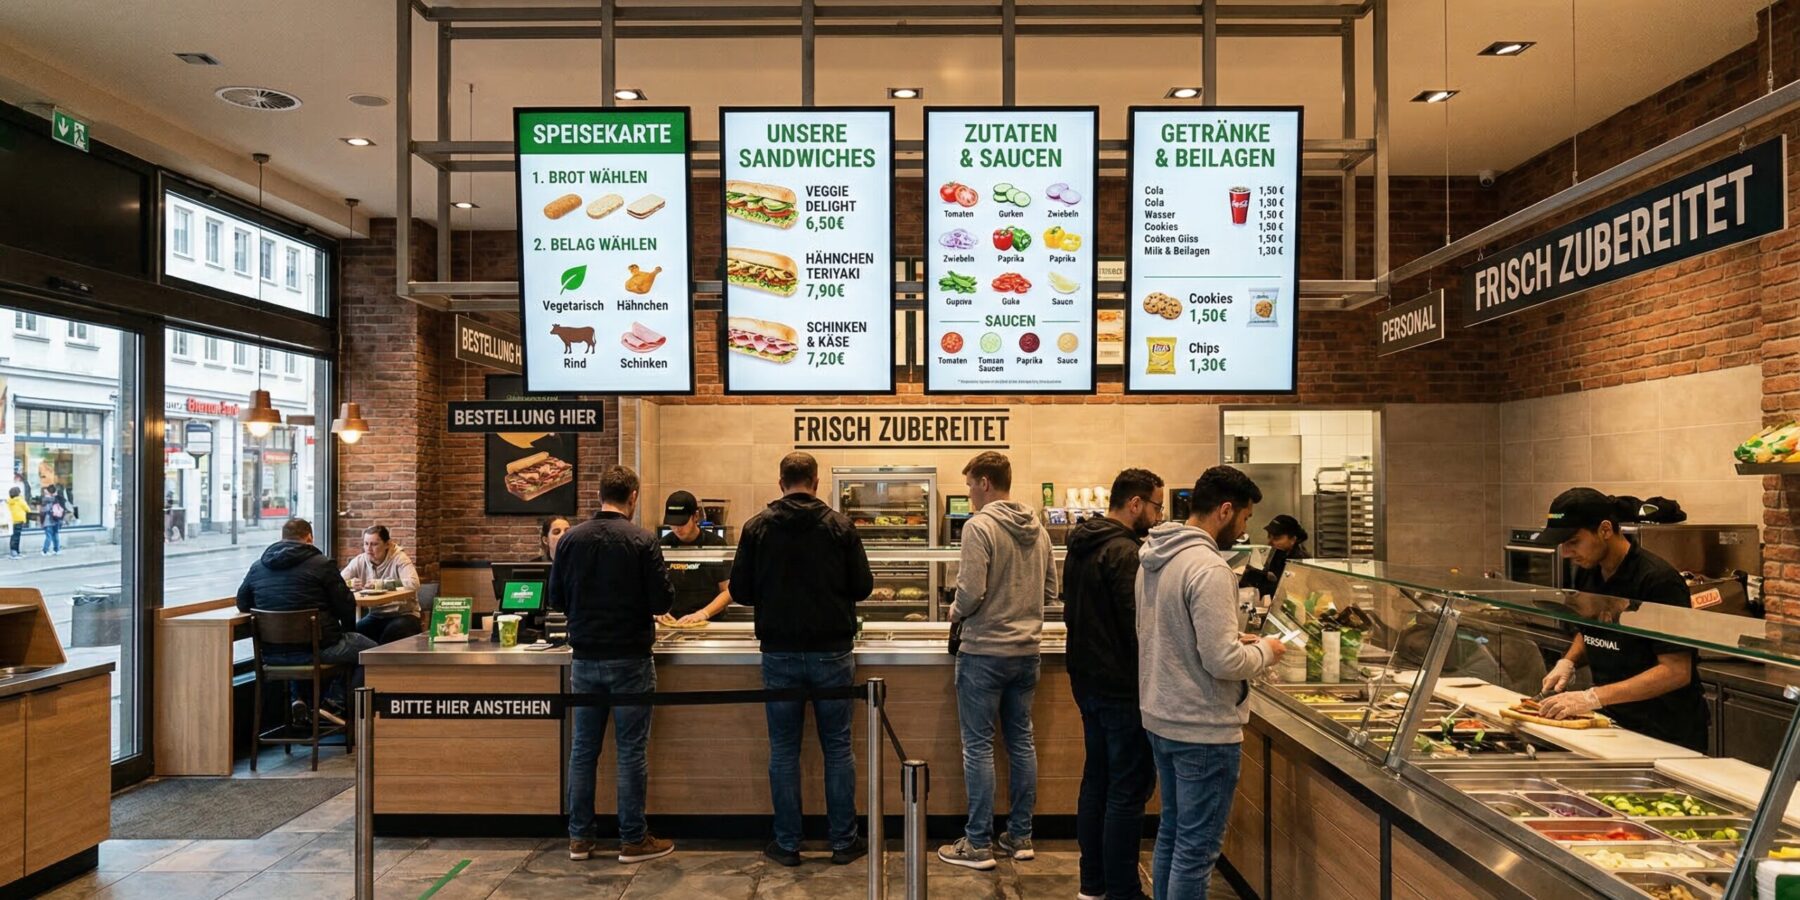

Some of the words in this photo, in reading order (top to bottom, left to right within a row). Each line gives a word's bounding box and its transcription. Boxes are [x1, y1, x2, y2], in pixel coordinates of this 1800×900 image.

[533, 123, 672, 144] SPEISEKARTE
[767, 123, 847, 143] UNSERE
[964, 123, 1057, 143] ZUTATEN
[1161, 119, 1270, 143] GETRÄNKE
[739, 148, 876, 168] SANDWICHES
[959, 148, 974, 168] &
[980, 148, 1062, 168] SAUCEN
[1155, 148, 1169, 168] &
[1175, 148, 1275, 168] BEILAGEN
[532, 171, 544, 184] 1.
[549, 170, 585, 184] BROT
[589, 167, 648, 184] WÄHLEN
[805, 185, 849, 197] VEGGIE
[1144, 185, 1164, 195] Cola
[1259, 185, 1278, 196] 1,50
[805, 200, 857, 212] DELIGHT
[1144, 197, 1165, 207] Cola
[943, 210, 974, 218] Tomaten
[998, 210, 1024, 218] Gurken
[1047, 210, 1079, 218] Zwiebeln
[1144, 210, 1176, 219] Wasser
[1259, 209, 1277, 220] 1,50
[805, 216, 845, 232] 6,50€
[1144, 221, 1179, 231] Cookies
[1259, 221, 1277, 232] 1,50
[533, 238, 546, 251] 2.
[550, 237, 595, 251] BELAG
[598, 234, 657, 251] WÄHLEN
[1258, 233, 1277, 245] 1,50
[1475, 245, 1552, 312] FRISCH
[1558, 164, 1754, 285] ZUBEREITET
[805, 250, 874, 264] HÄHNCHEN
[1164, 246, 1171, 256] &
[1173, 246, 1210, 257] Beilagen
[1258, 245, 1276, 257] 1,30
[943, 255, 975, 263] Zwiebeln
[997, 255, 1025, 264] Paprika
[1049, 255, 1077, 264] Paprika
[805, 267, 860, 279] TERIYAKI
[806, 283, 845, 300] 7,90€
[1189, 292, 1233, 304] Cookies
[542, 300, 604, 313] Vegetarisch
[617, 299, 669, 311] Hähnchen
[985, 314, 1036, 327] SAUCEN
[1189, 308, 1228, 325] 1,50€
[806, 321, 867, 333] SCHINKEN
[1382, 305, 1436, 344] PERSONAL
[462, 327, 515, 363] BESTELLUNG
[515, 344, 522, 366] H
[806, 336, 815, 347] &
[818, 334, 850, 347] KÄSE
[1188, 342, 1220, 356] Chips
[563, 357, 587, 369] Rind
[620, 357, 668, 369] Schinken
[806, 352, 845, 368] 7,20€
[1016, 357, 1043, 366] Paprika
[1189, 358, 1227, 374] 1,30€
[978, 364, 1004, 372] Saucen
[454, 409, 556, 426] BESTELLUNG
[559, 409, 597, 425] HIER
[794, 416, 871, 442] FRISCH
[878, 416, 1010, 442] ZUBEREITET
[1583, 634, 1620, 651] PERSONAL
[390, 700, 433, 715] BITTE
[435, 700, 470, 715] HIER
[472, 700, 551, 715] ANSTEHEN
